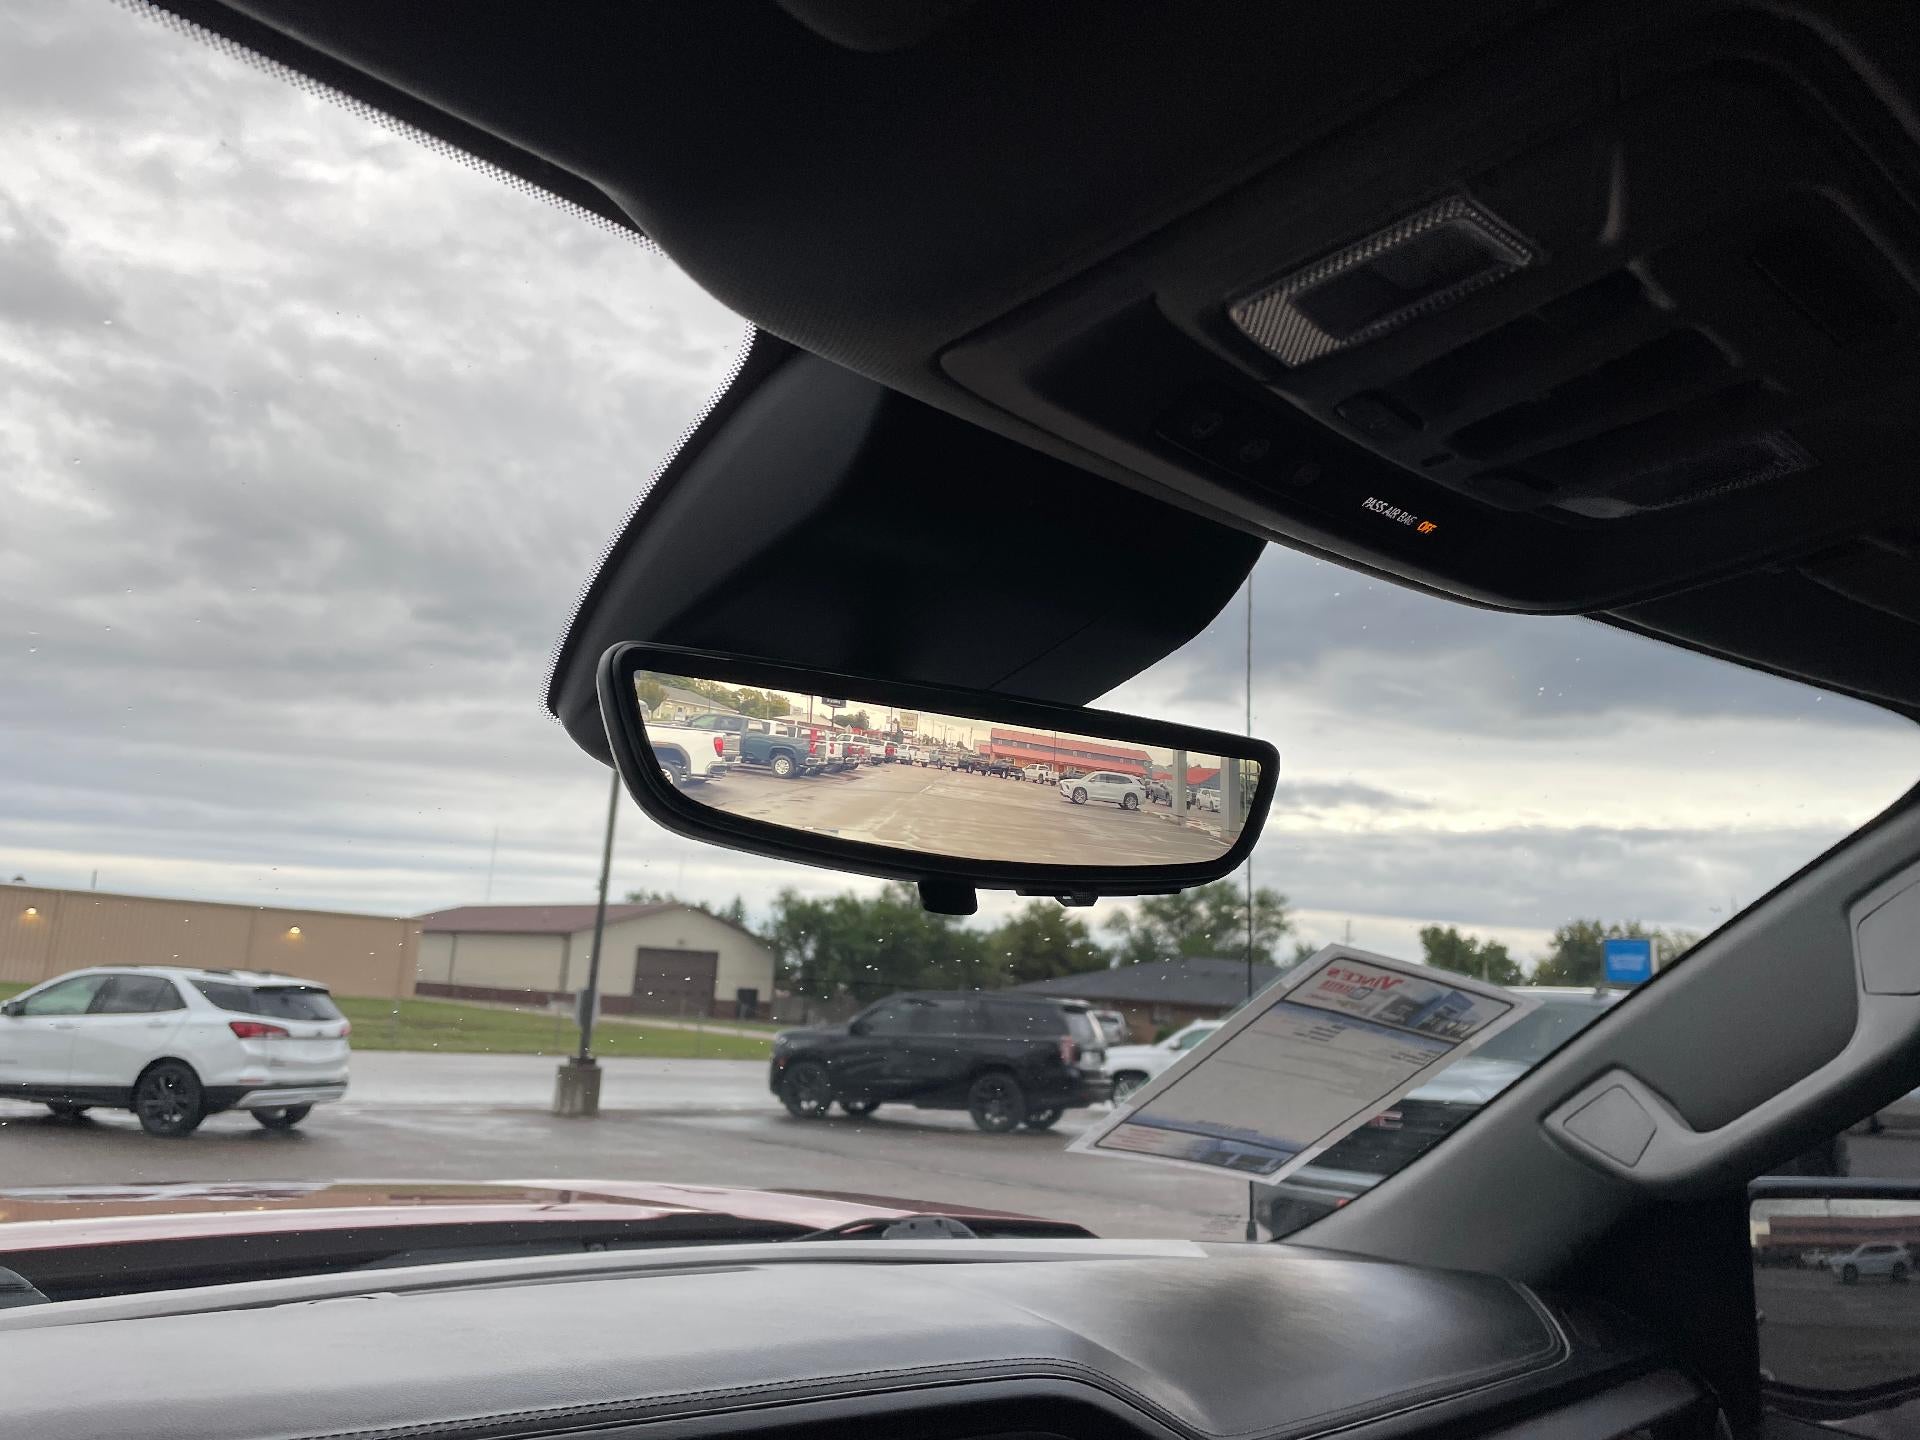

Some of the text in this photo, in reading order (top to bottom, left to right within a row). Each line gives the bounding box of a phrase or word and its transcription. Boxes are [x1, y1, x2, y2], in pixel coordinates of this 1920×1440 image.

[1362, 497, 1437, 534] PASS AIR BAG OFF
